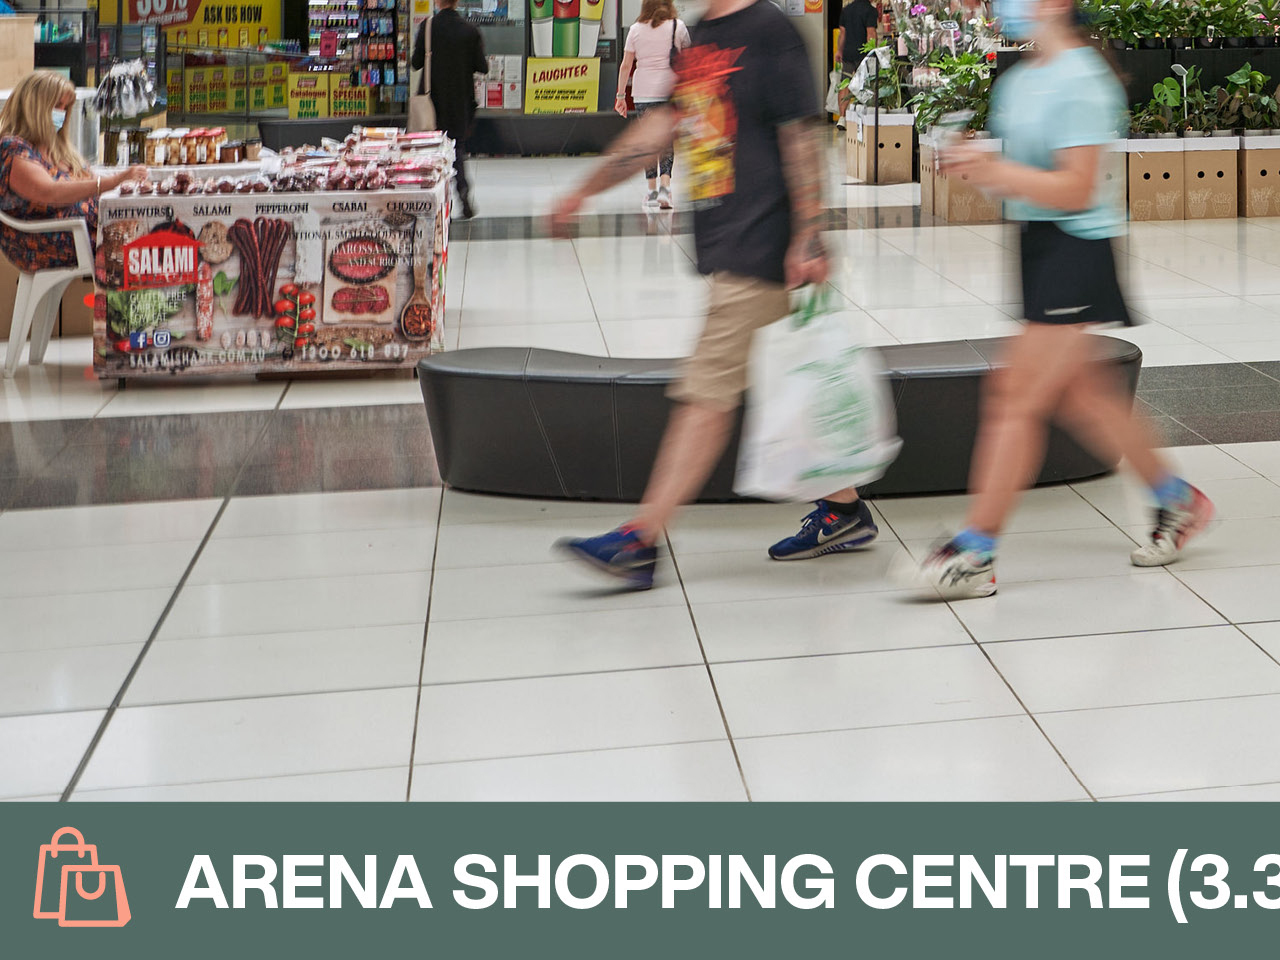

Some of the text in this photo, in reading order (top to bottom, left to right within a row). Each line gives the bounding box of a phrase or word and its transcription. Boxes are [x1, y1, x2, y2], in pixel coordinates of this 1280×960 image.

[203, 5, 262, 24] ASK US HOW
[532, 64, 588, 84] LAUGHTER
[290, 90, 327, 99] Catalogue
[333, 90, 366, 100] SPECIAL
[299, 100, 317, 110] OUT
[333, 100, 366, 111] SPECIAL
[193, 204, 231, 216] SALAMI
[255, 202, 309, 214] PEPPERONI
[332, 201, 367, 212] CSABAI
[386, 201, 432, 212] CHORIZO
[333, 243, 379, 254] BAROSSA
[128, 246, 194, 275] SALAMI
[166, 290, 187, 301] FREE
